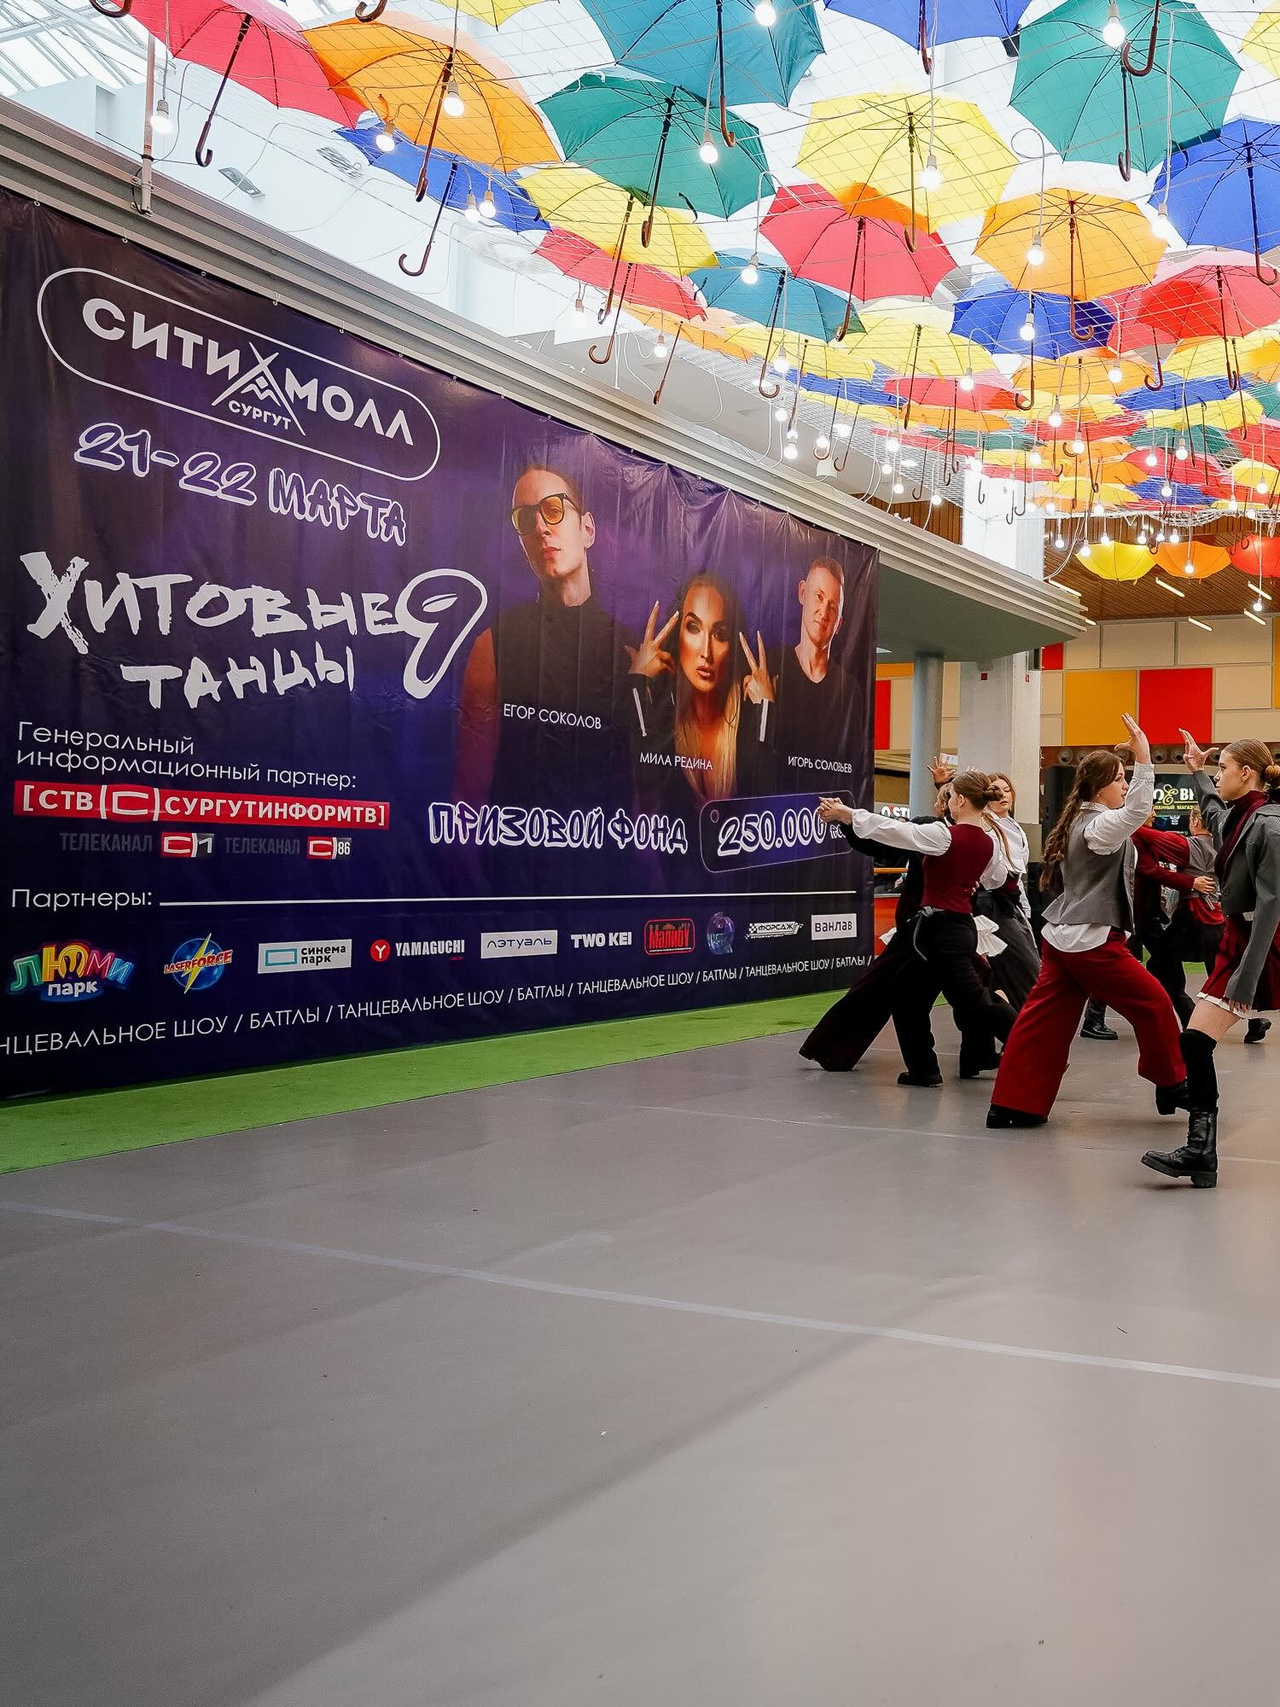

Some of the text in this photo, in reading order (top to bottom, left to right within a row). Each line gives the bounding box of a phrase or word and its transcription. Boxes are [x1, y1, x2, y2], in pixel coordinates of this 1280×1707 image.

[82, 298, 414, 446] СИТИ МОЛЛ
[228, 400, 292, 430] СУРГУТ
[73, 422, 407, 547] 21-22 МАРТА
[120, 642, 355, 709] ТАНЦЫ
[503, 703, 602, 730] ЕГОР СОКОЛОВ
[18, 721, 195, 756] Генеральный
[17, 749, 357, 790] информационный партнер:
[640, 753, 713, 771] МИЛА РЕДИНА
[788, 756, 852, 774] ИГОРЬ СОЛОВЬЕВ
[429, 801, 688, 854] ПРИЗОВОЙ ФОНД
[717, 807, 828, 857] 250.000
[60, 831, 153, 853] ТЕЛЕКАНАЛ
[225, 836, 300, 855] ТЕЛЕКАНАЛ
[11, 888, 153, 911] Партнеры:
[758, 923, 794, 931] ФОРСАЖ
[815, 921, 853, 932] ванлав
[301, 945, 346, 955] синема
[396, 940, 465, 957] YAMAGUCHI
[571, 932, 633, 949] TWO KEI
[164, 949, 233, 974] LASERFORCE
[301, 954, 332, 966] парк
[47, 981, 98, 997] парк
[174, 1015, 227, 1038] ШОУ
[250, 1006, 320, 1030] БАТТЛЫ
[338, 993, 465, 1020] ТАНЦЕВАЛЬНОЕ
[468, 989, 504, 1007] ШОУ
[518, 984, 565, 1001] БАТТЛЫ
[577, 974, 665, 995] ТАНЦЕВАЛЬНОЕ
[668, 971, 694, 986] ШОУ
[703, 968, 737, 982] БАТТЛЫ
[745, 961, 809, 977] ТАНЦЕВАЛЬНОЕ
[811, 959, 830, 970] ШОУ
[836, 955, 866, 967] БАТТЛЫ
